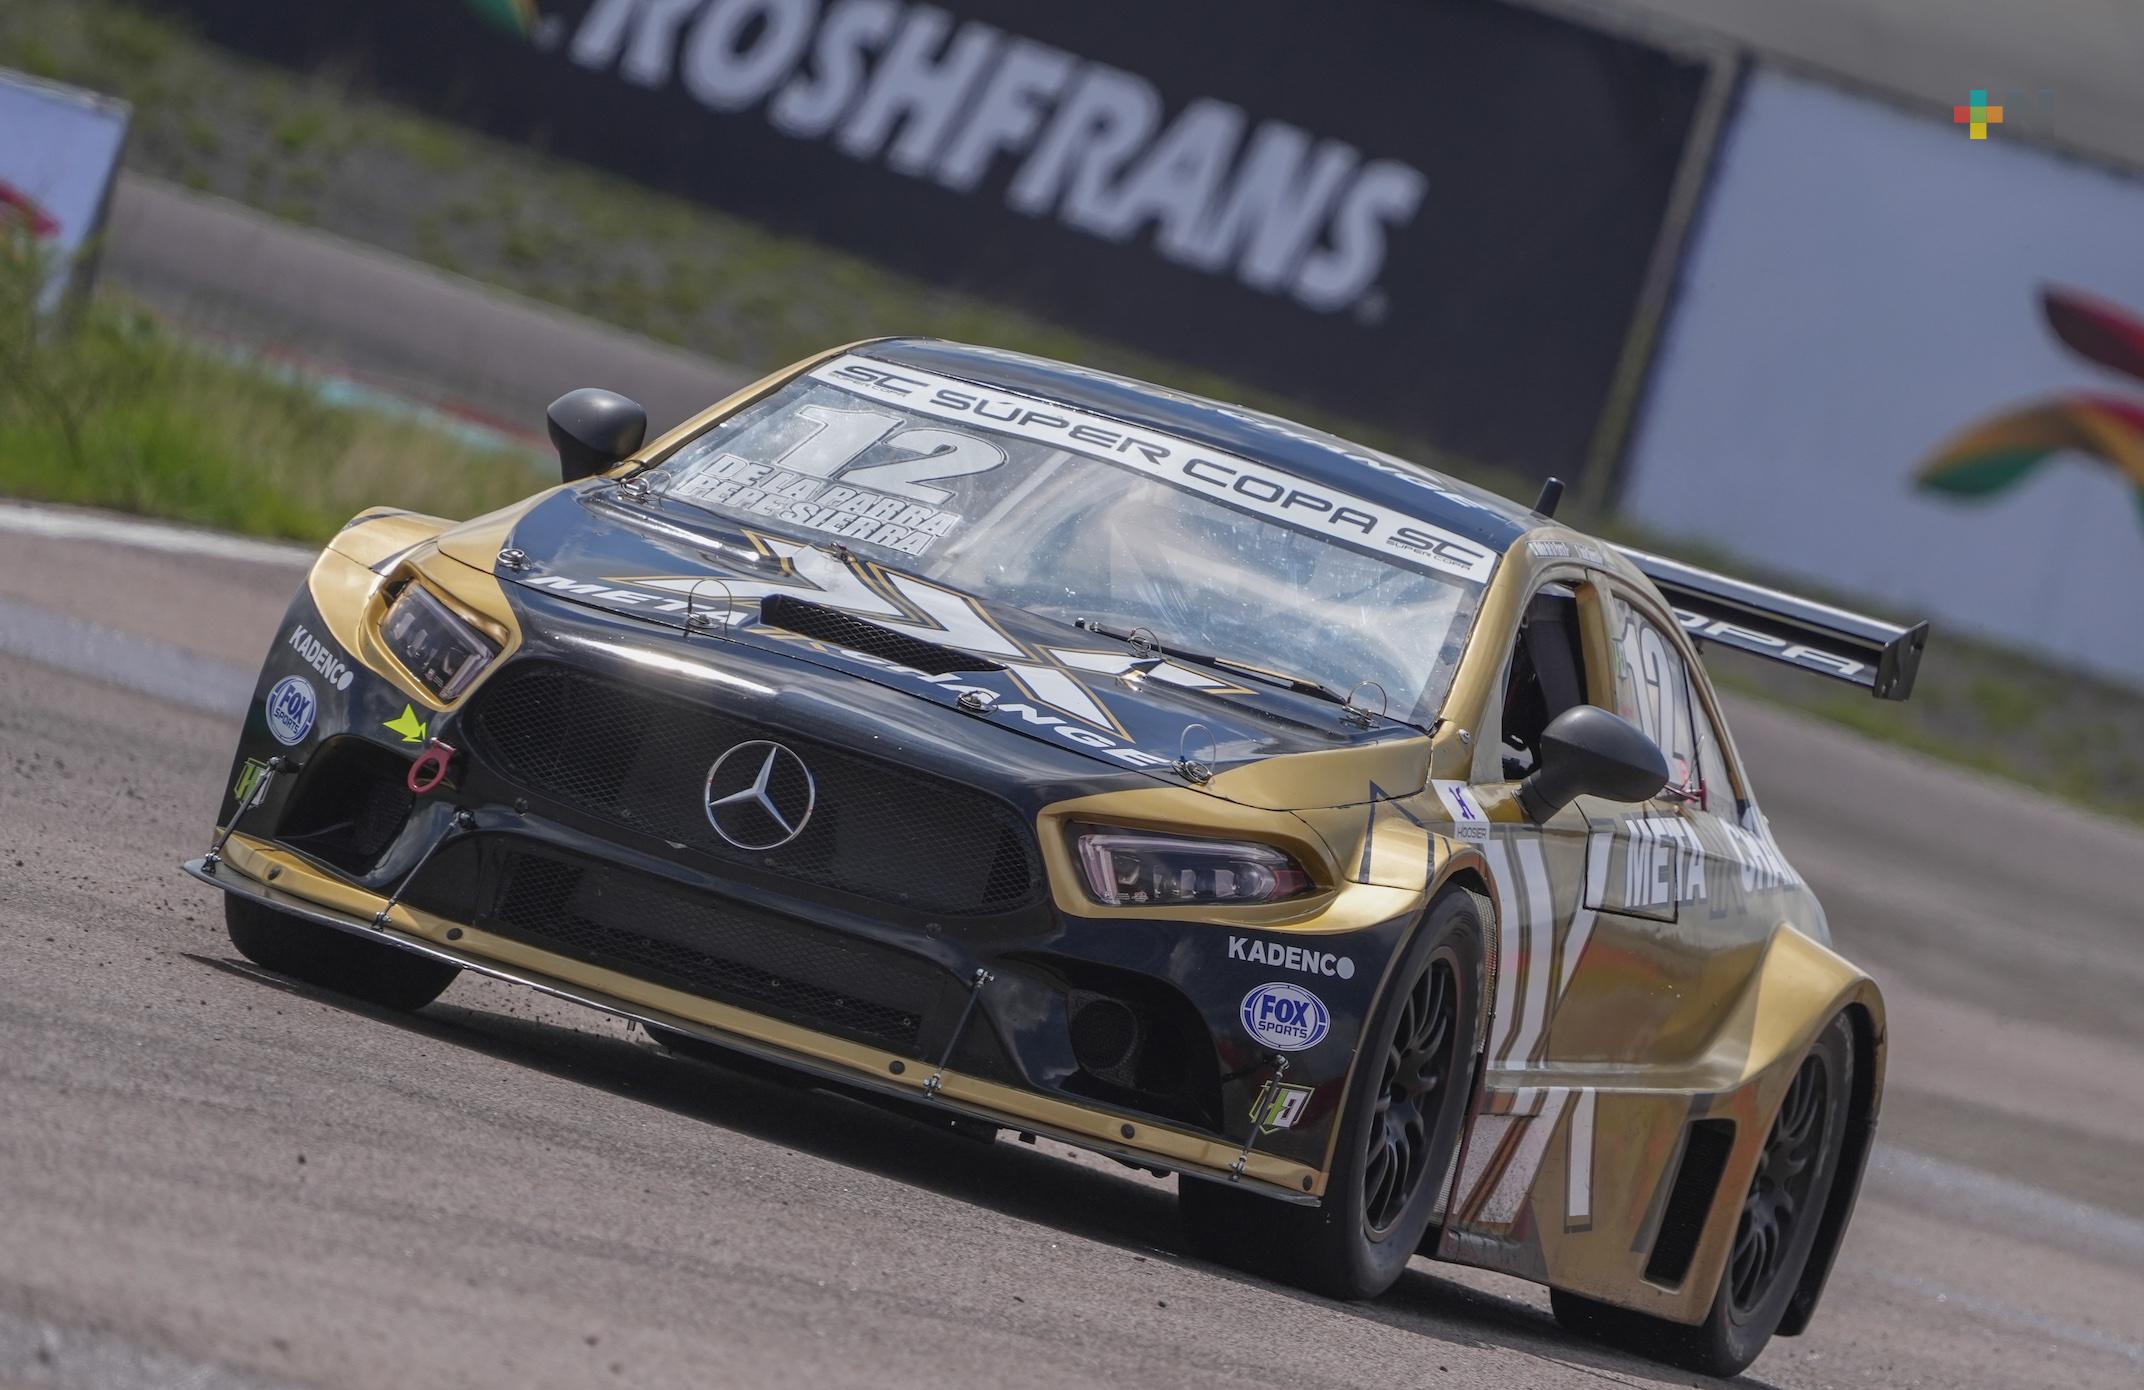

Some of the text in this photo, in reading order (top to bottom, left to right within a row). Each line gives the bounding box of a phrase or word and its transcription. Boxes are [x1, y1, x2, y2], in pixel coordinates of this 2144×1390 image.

[776, 404, 1008, 505] 12
[929, 389, 1171, 466] SUPER
[1182, 457, 1378, 534] COPA
[1388, 527, 1485, 566] SC
[778, 500, 937, 557] SIERRA
[816, 486, 963, 538] PARRA
[526, 575, 750, 626] META
[273, 707, 300, 734] SPORTS
[279, 684, 311, 724] FOX
[1625, 816, 1707, 908] META
[1258, 1020, 1308, 1039] SPORTS
[1260, 994, 1310, 1027] FOX
